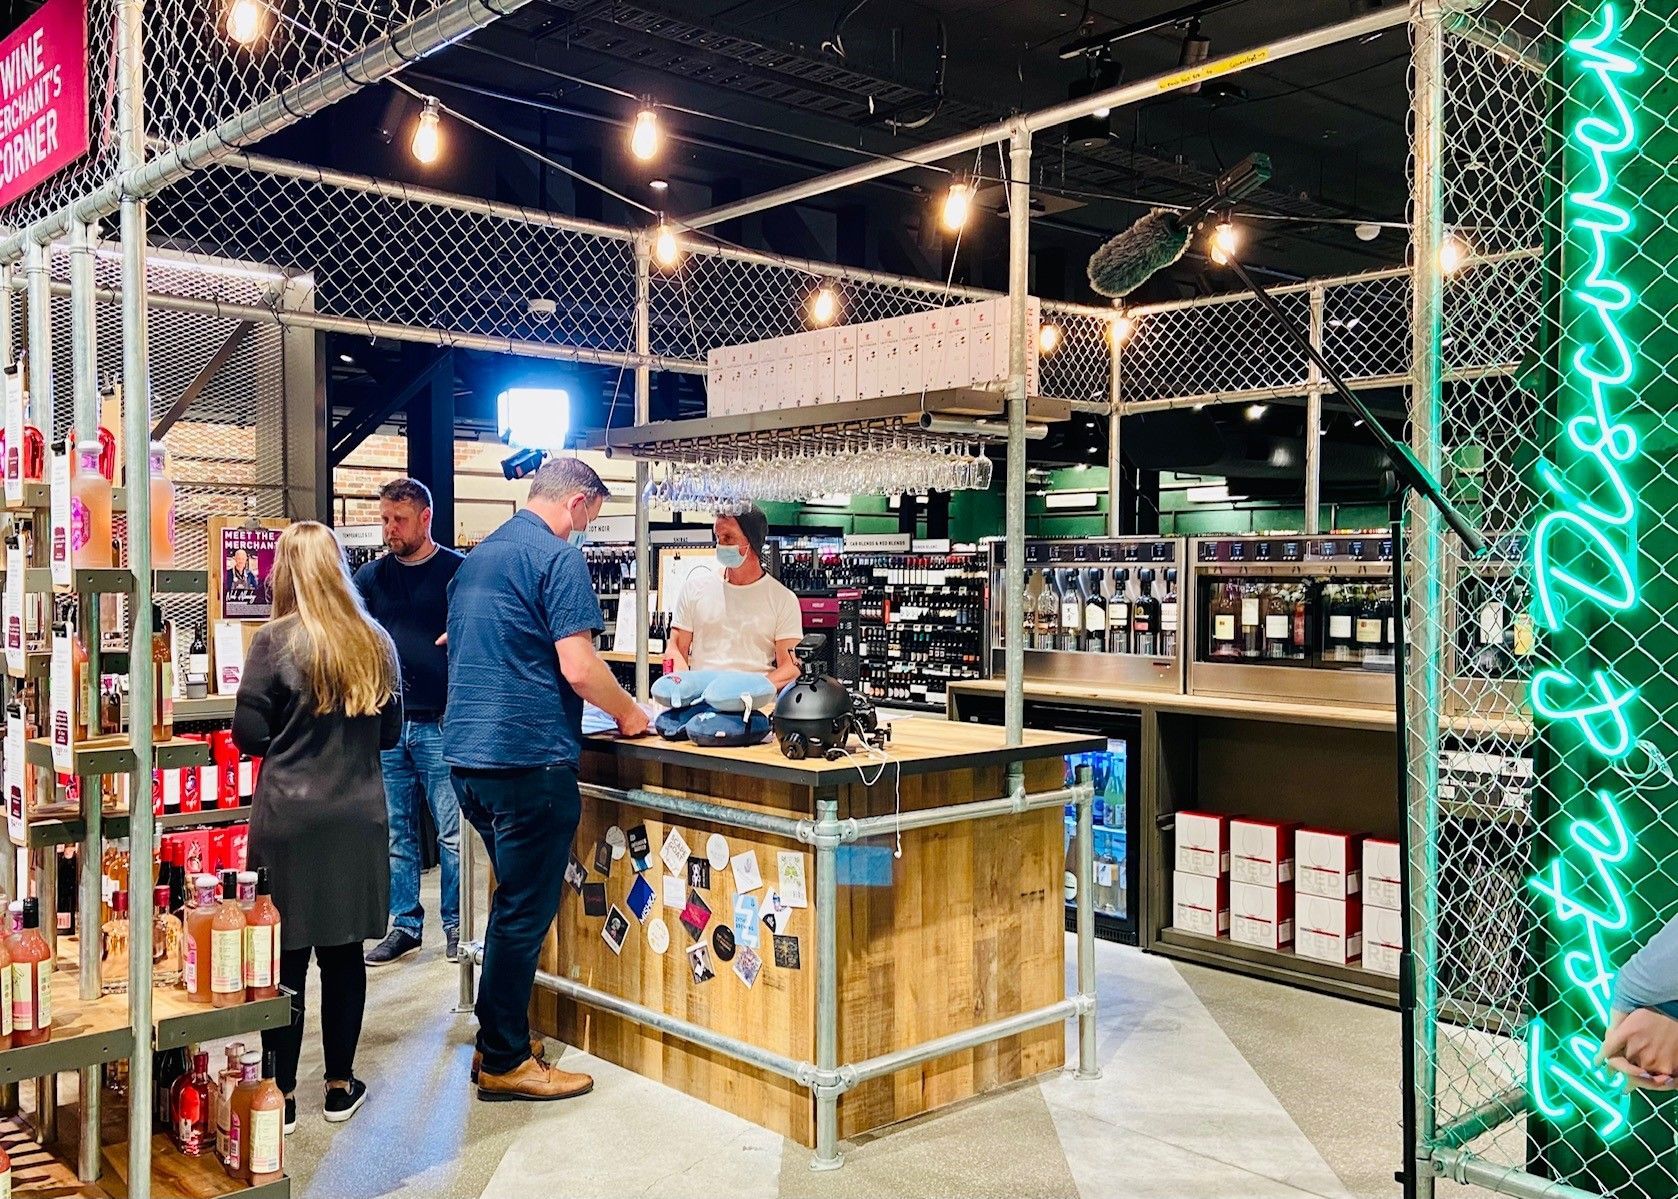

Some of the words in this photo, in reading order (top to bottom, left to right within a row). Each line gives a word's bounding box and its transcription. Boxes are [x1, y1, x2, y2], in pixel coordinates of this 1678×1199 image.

[0, 27, 45, 101] WINE
[0, 64, 62, 141] ERCHANT'S
[1534, 2, 1639, 630] Discover
[224, 531, 253, 540] MEET
[255, 532, 275, 540] THE
[1530, 669, 1638, 758] &
[1180, 849, 1215, 868] RED
[1234, 861, 1272, 879] RED
[1300, 869, 1340, 888] RED
[1368, 881, 1400, 897] RE
[639, 891, 657, 925] MISHKA
[1177, 908, 1213, 926] RED
[1235, 920, 1272, 938] RED
[1300, 934, 1340, 954] RED
[1367, 946, 1400, 962] RE
